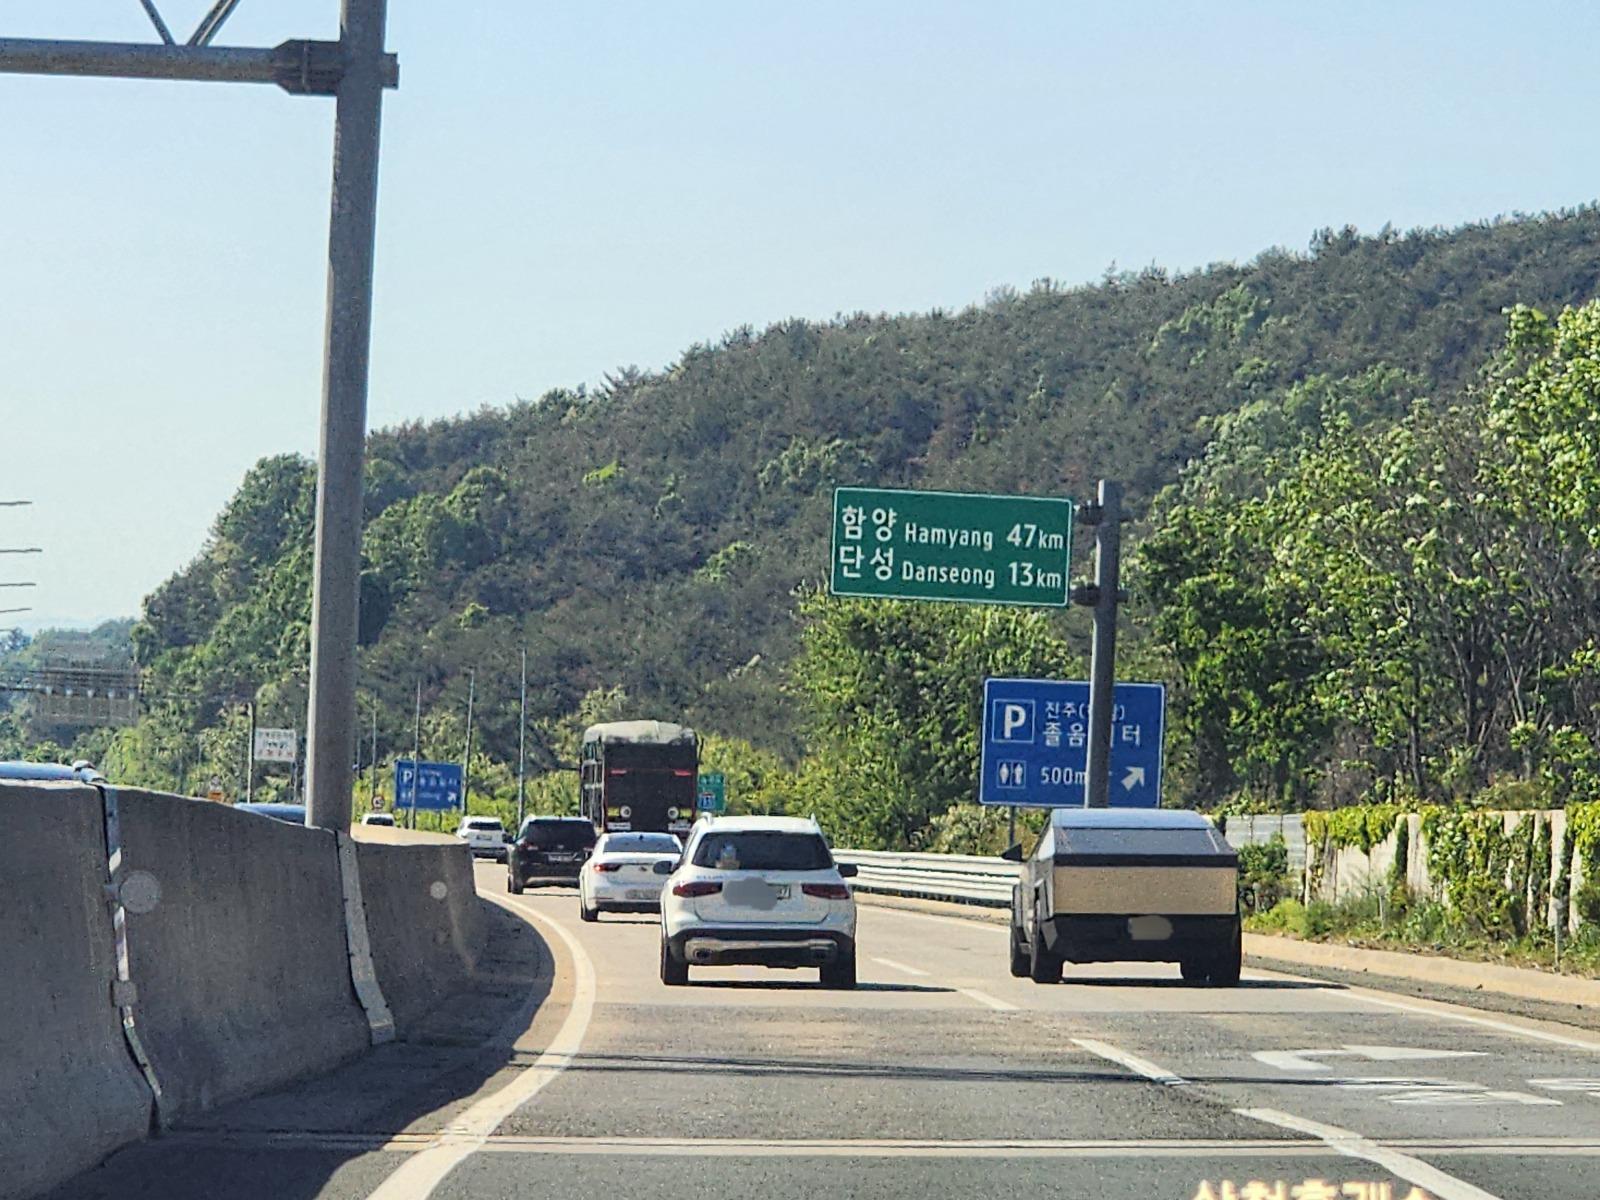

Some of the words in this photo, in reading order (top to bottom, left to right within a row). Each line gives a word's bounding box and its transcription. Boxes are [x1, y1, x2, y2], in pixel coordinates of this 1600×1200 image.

[842, 505, 898, 542] 함양
[904, 522, 994, 551] Hamyang
[1006, 523, 1064, 550] 47km
[839, 545, 894, 581] 단성
[901, 561, 995, 589] Danseong
[1007, 561, 1062, 588] 13km
[1003, 704, 1027, 739] P
[1042, 722, 1140, 748] 졸음터
